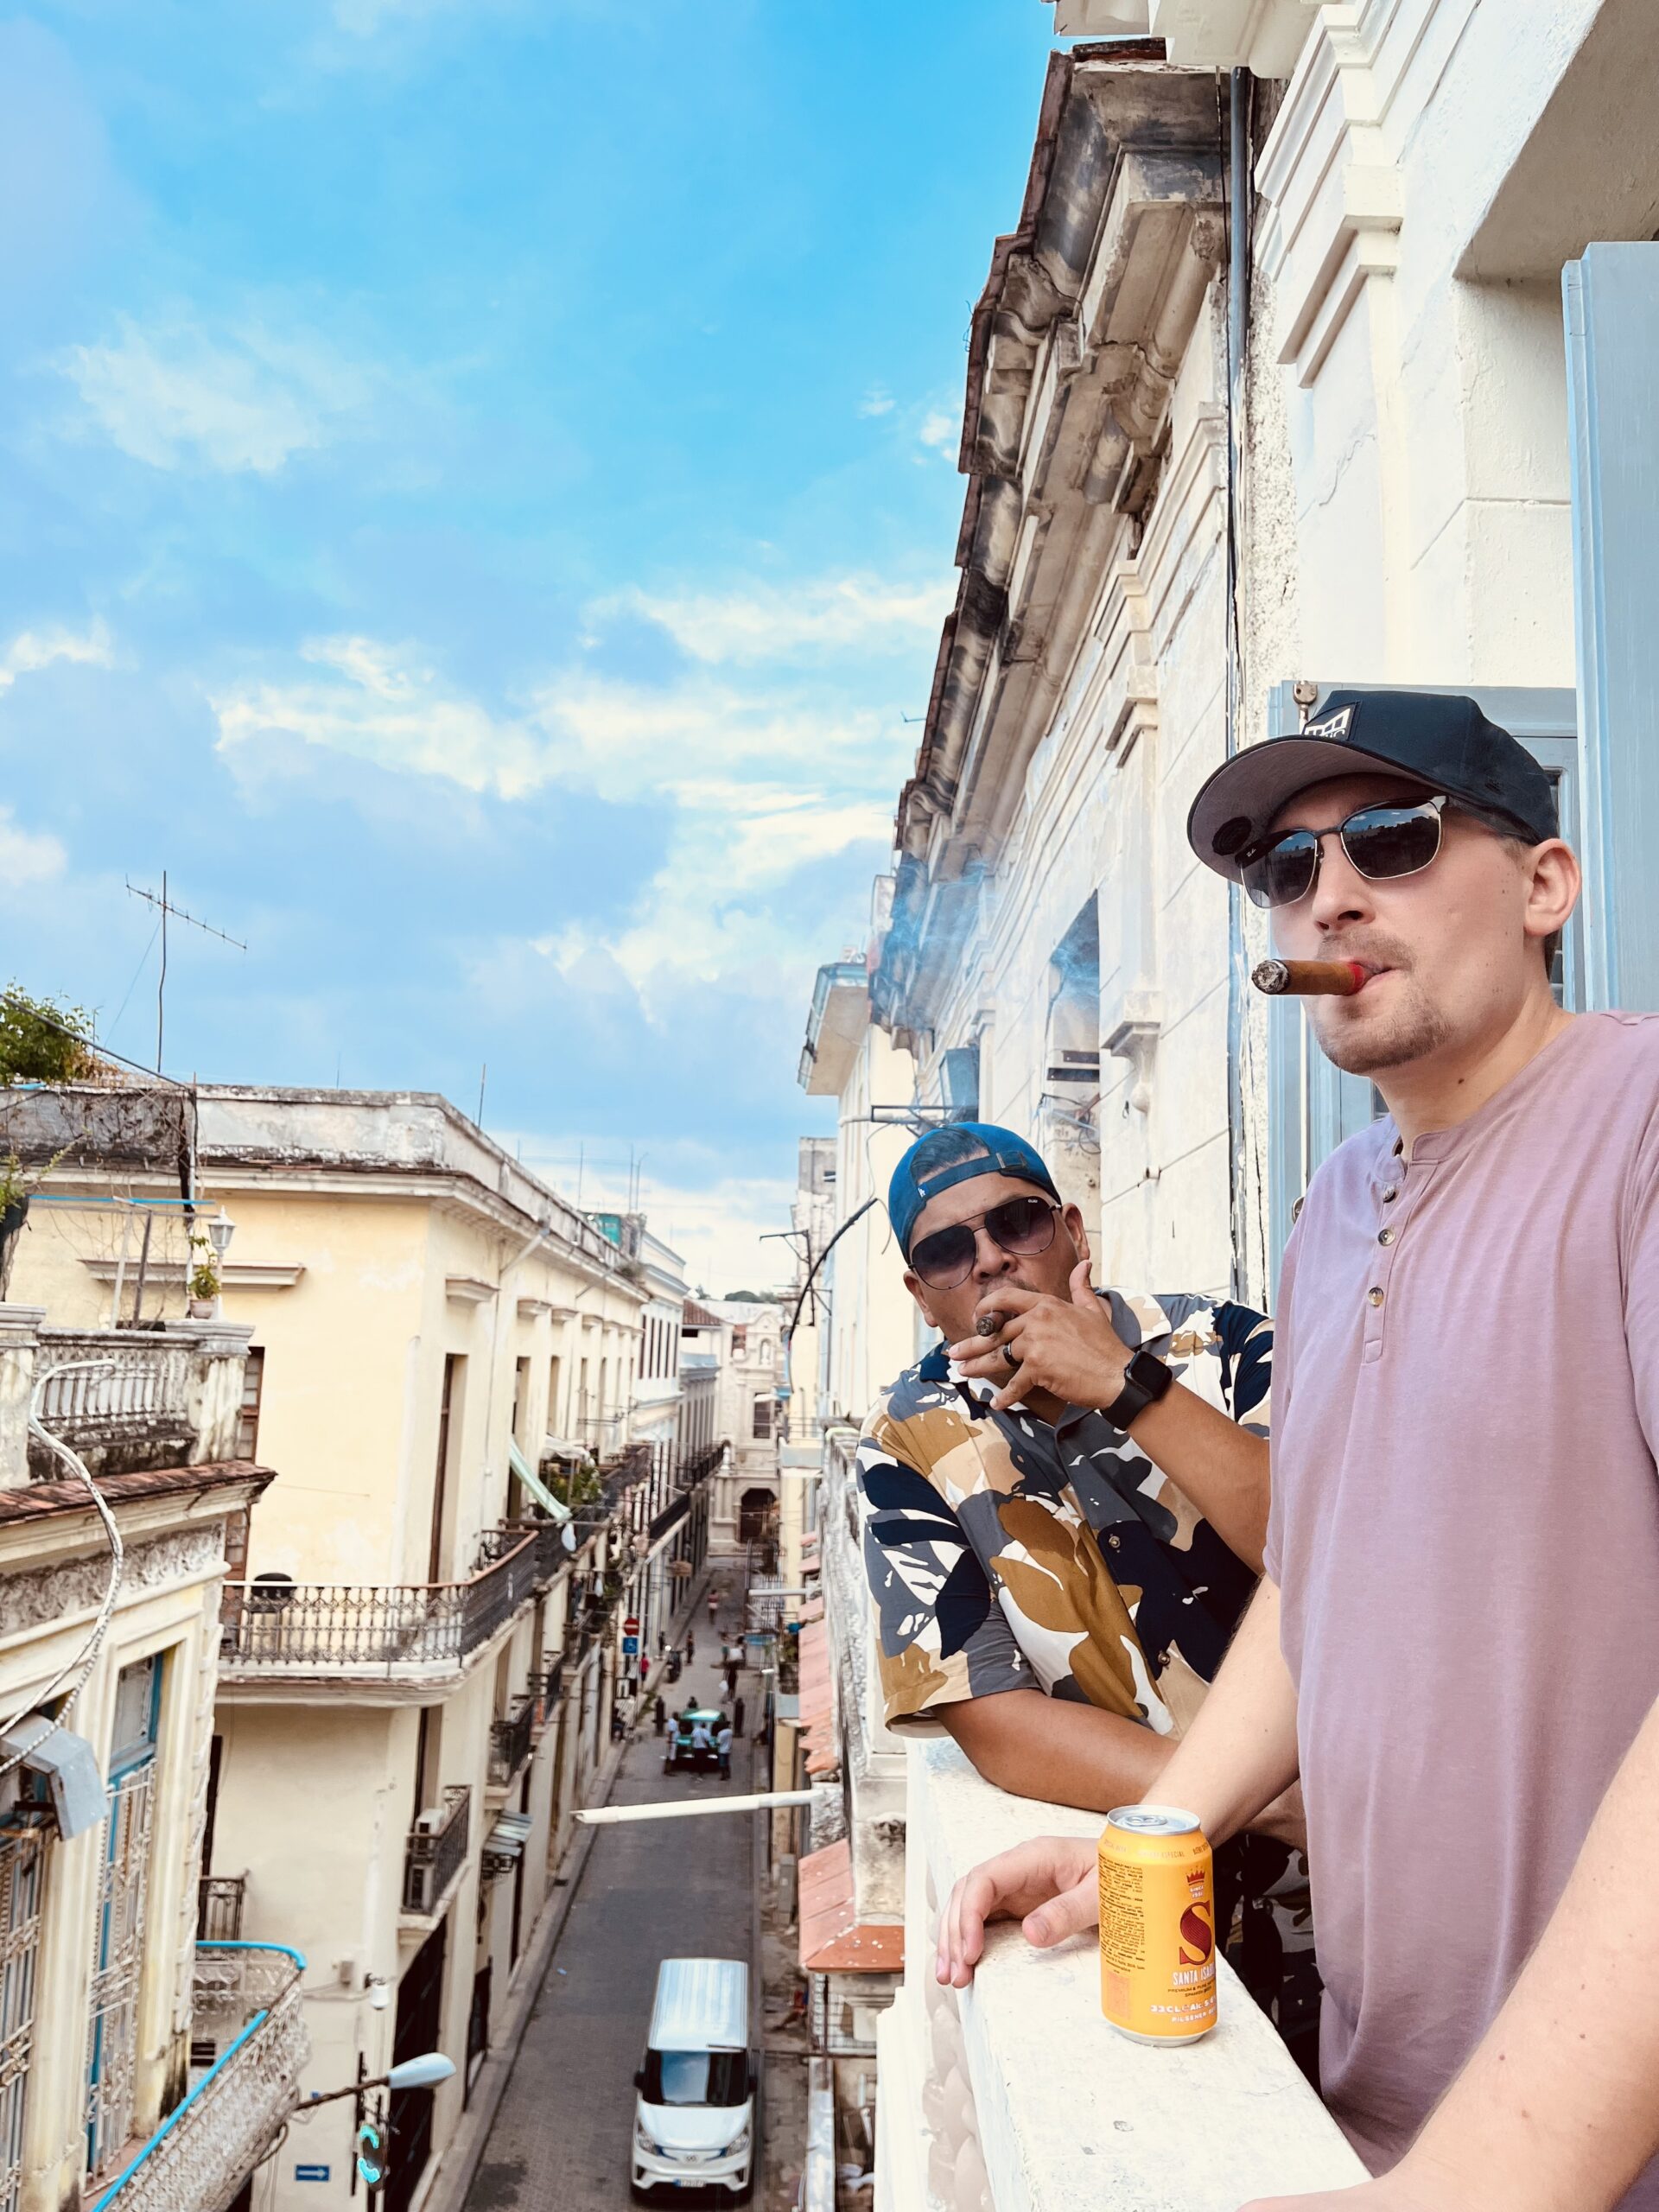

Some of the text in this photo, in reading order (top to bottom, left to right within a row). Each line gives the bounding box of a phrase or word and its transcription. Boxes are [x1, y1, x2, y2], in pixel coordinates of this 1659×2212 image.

[1179, 1900, 1212, 1966] S
[1173, 1970, 1198, 1986] SANTA
[1172, 2012, 1206, 2022] PILSENER
